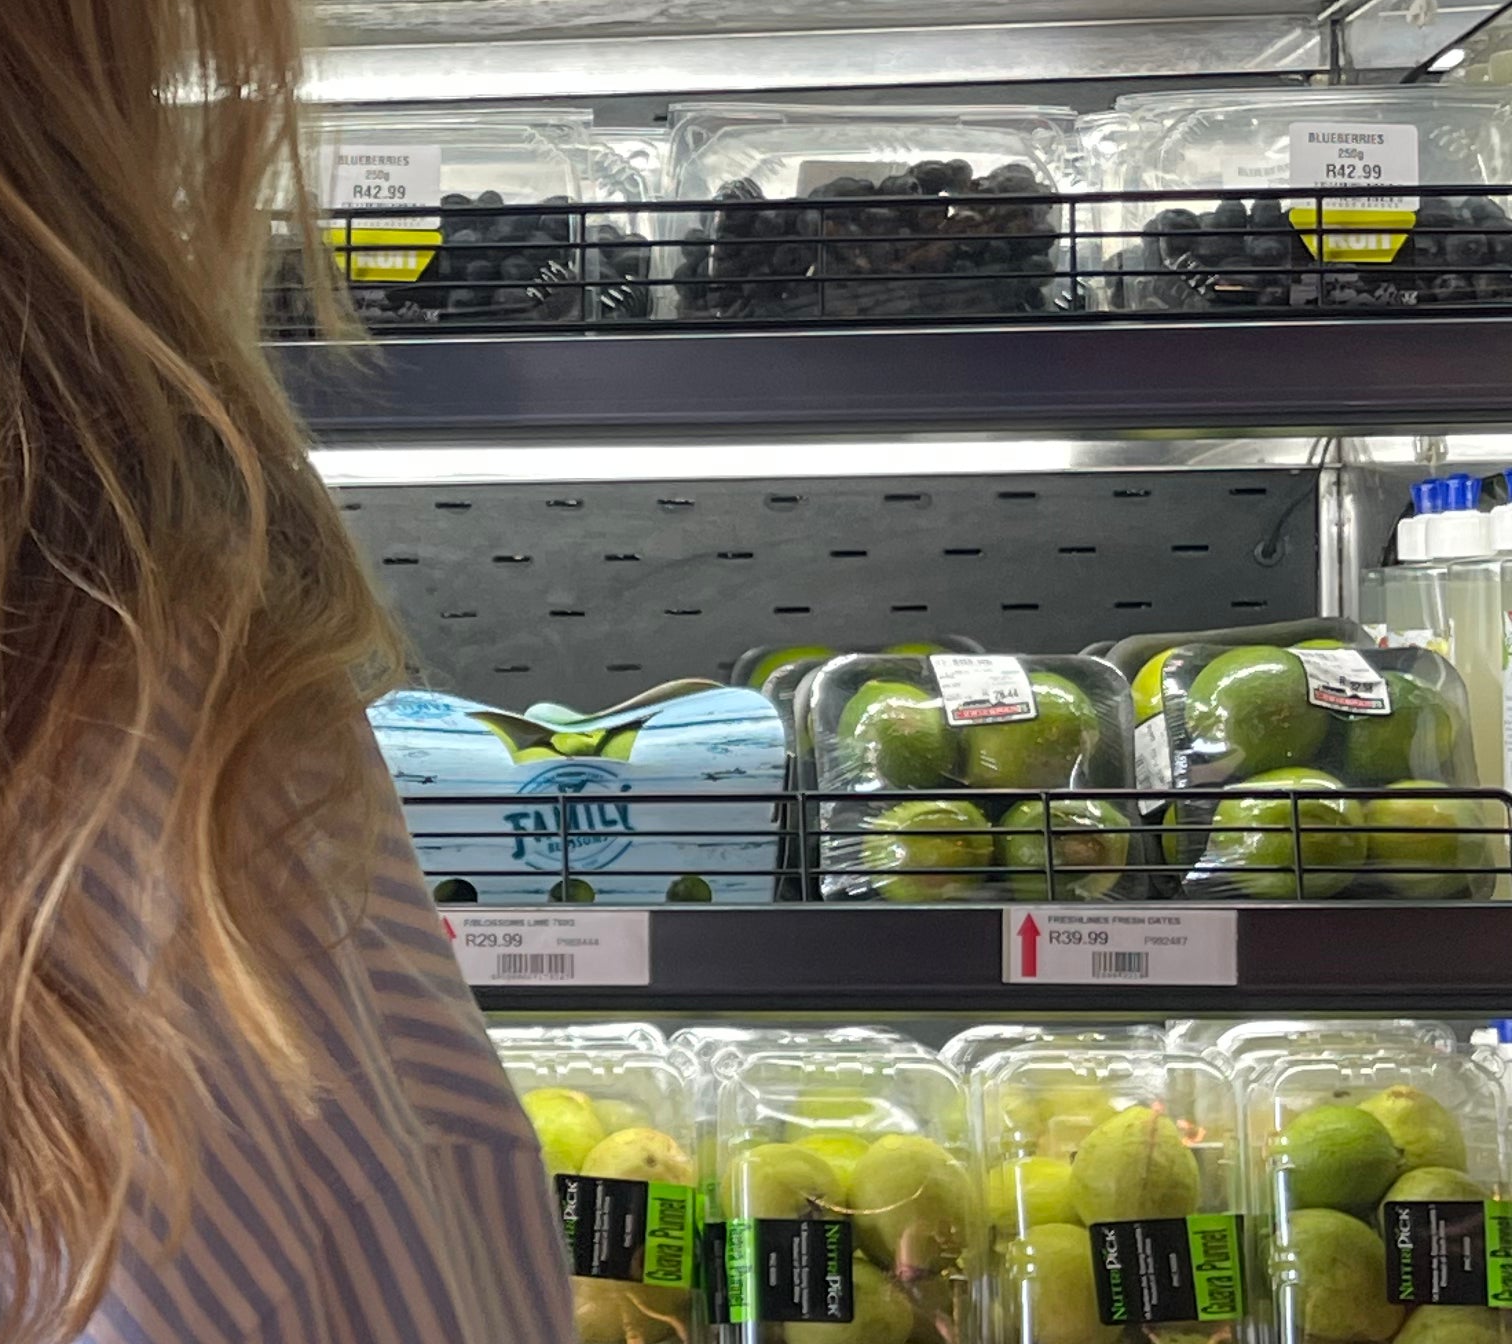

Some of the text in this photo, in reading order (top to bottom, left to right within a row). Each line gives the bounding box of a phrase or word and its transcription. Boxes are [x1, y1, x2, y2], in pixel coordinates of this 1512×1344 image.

[1308, 132, 1385, 145] BLUEBERRIES
[336, 156, 410, 167] BLUEBERRIES
[1326, 164, 1382, 179] R42.99
[353, 185, 406, 199] R42.99
[1112, 916, 1145, 925] FRESH
[465, 934, 523, 947] R29.99
[1049, 931, 1109, 945] R39.99
[645, 1243, 684, 1281] Guava
[1192, 1227, 1238, 1315] Guava Punnet
